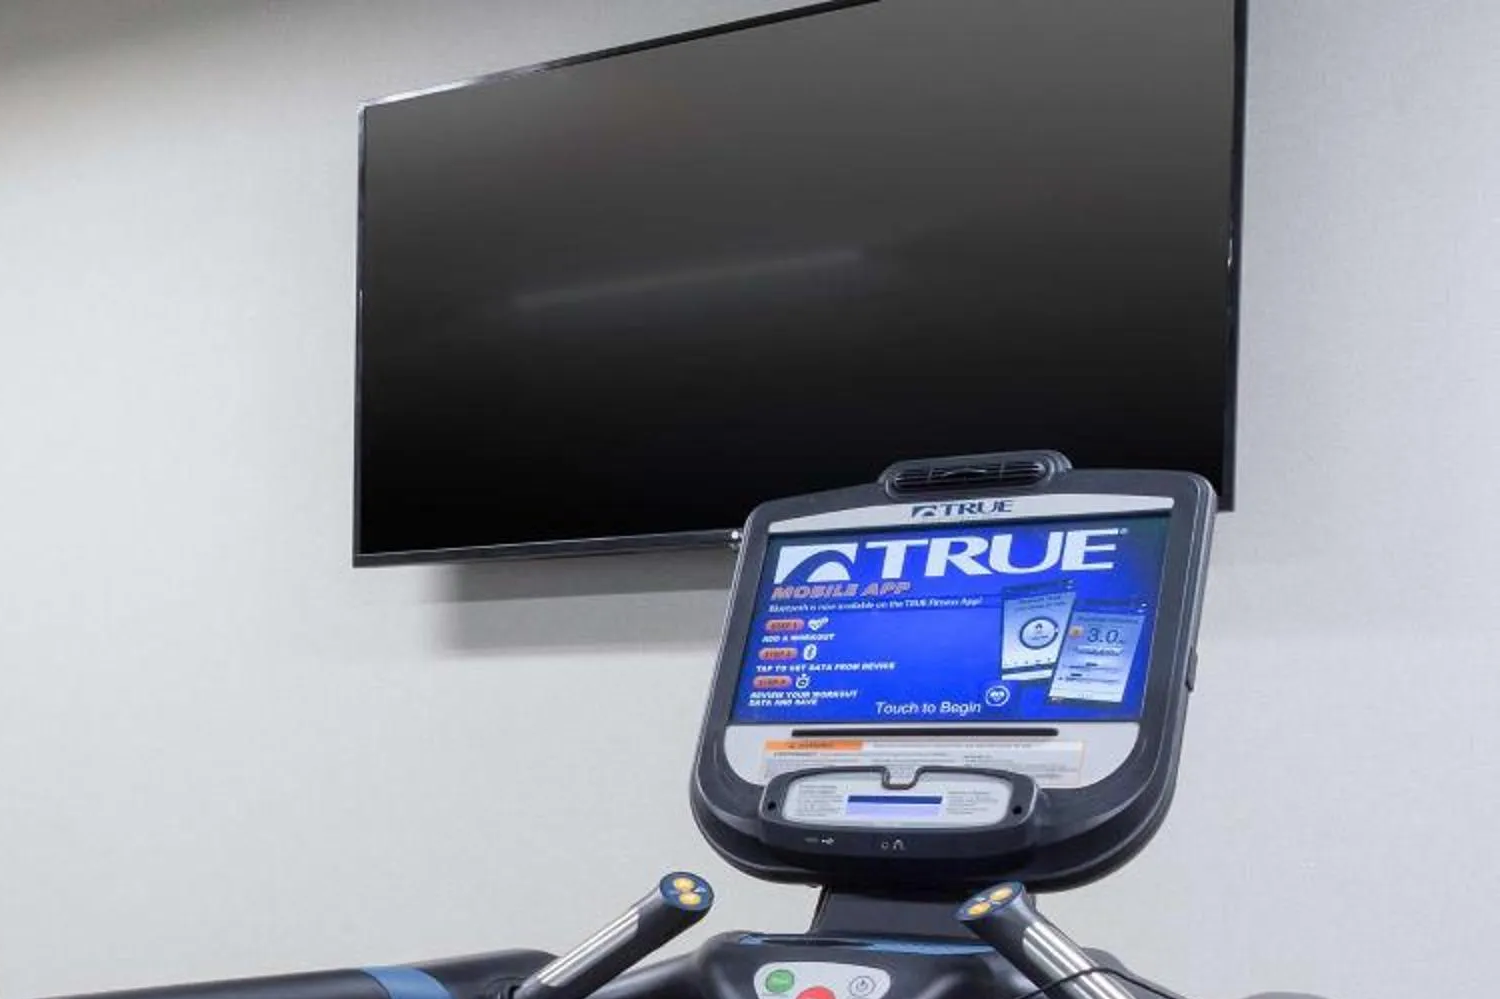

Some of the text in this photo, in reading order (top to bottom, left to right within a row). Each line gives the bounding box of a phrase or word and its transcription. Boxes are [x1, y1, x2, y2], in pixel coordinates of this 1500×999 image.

[942, 499, 1014, 516] TRUE
[865, 528, 1119, 580] TRUE
[771, 581, 911, 600] MOBILE APP
[1087, 627, 1119, 643] 3.0
[875, 701, 982, 717] Touch to Begin
